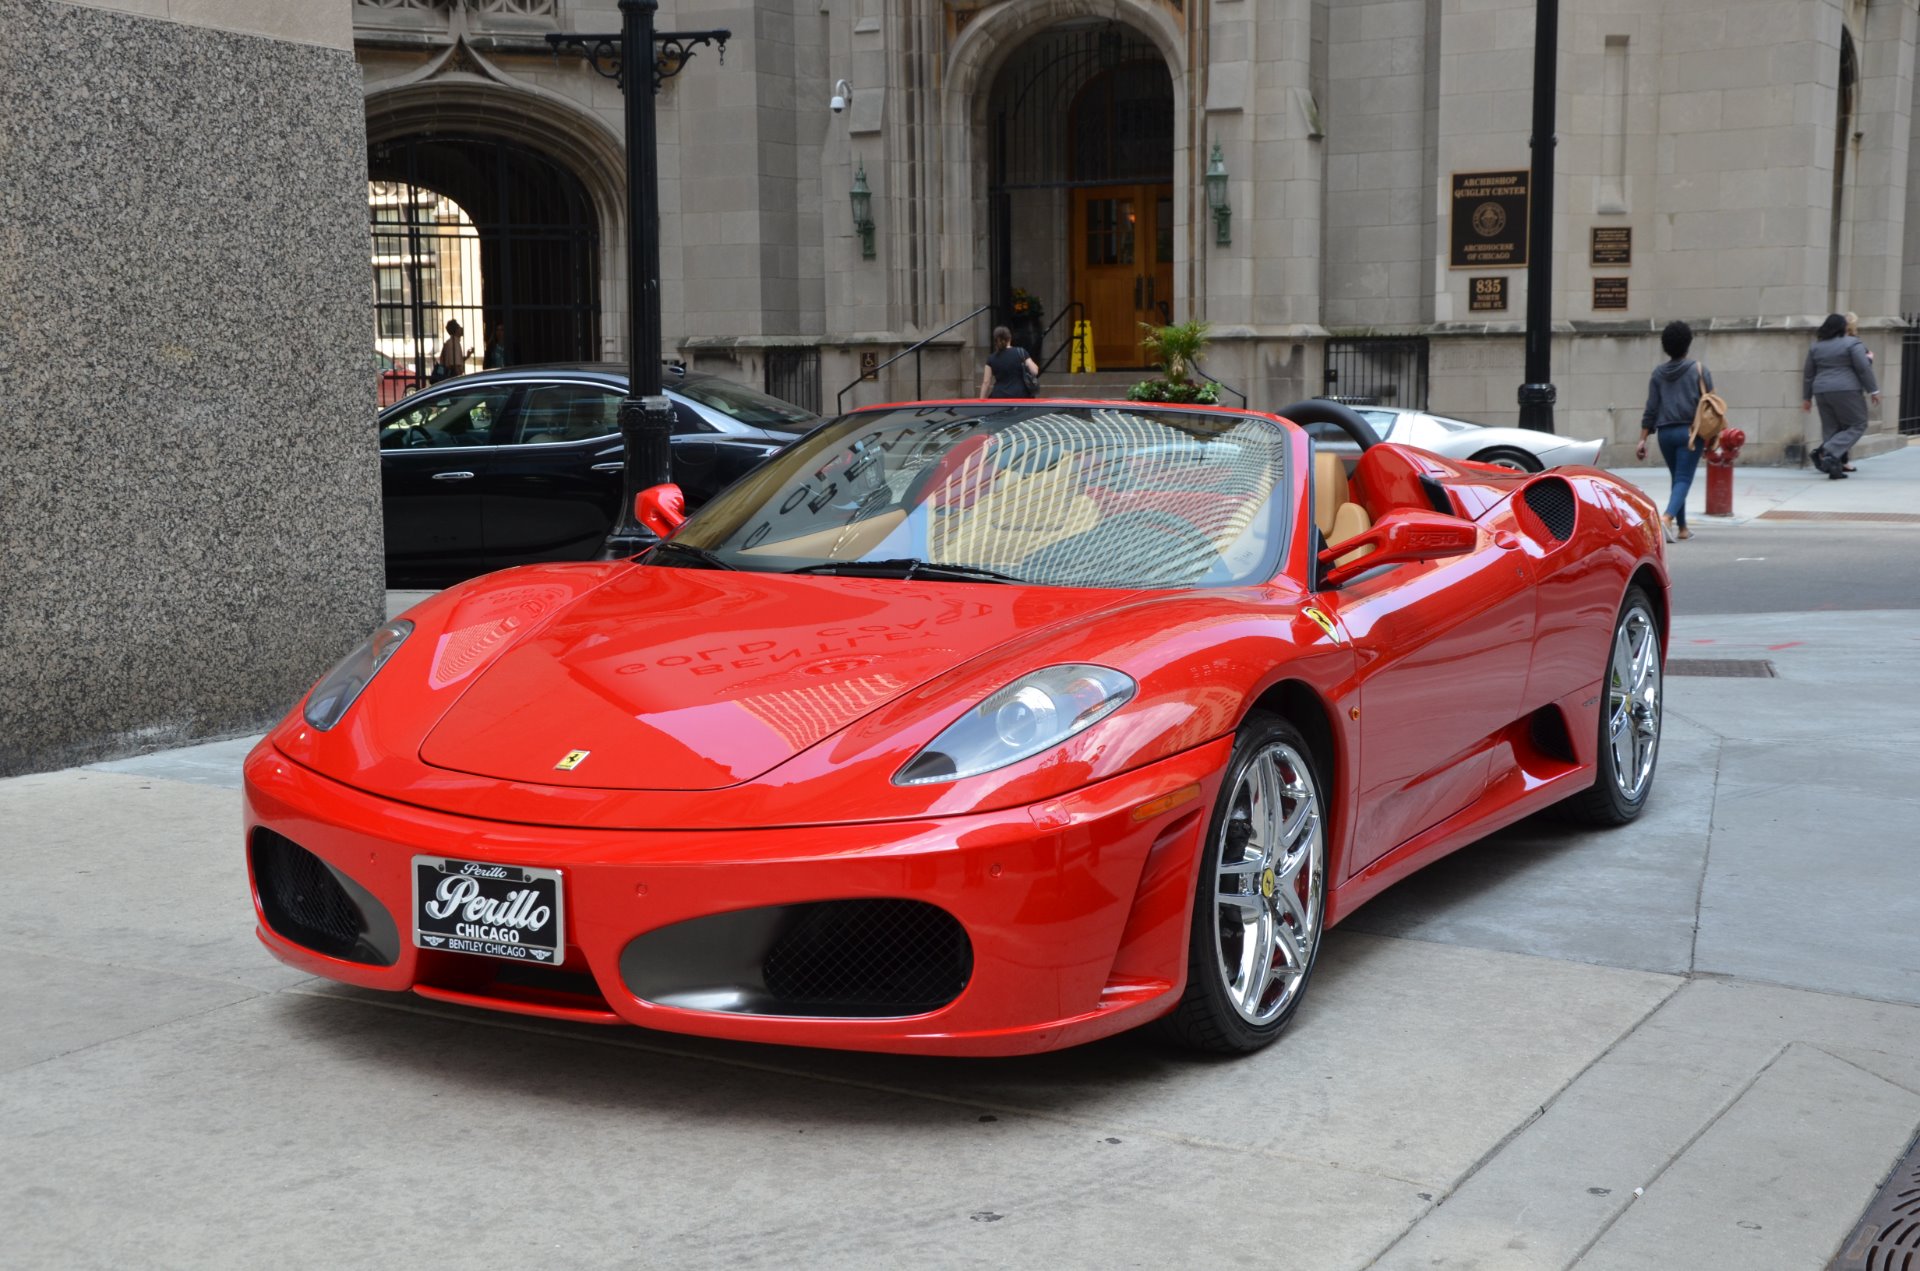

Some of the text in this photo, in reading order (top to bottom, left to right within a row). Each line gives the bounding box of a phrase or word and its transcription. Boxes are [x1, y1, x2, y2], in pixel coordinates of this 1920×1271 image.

[1463, 176, 1518, 187] ARCHBISHOP
[1454, 186, 1526, 198] QUIGLEY CENTER
[1463, 243, 1514, 252] ARCHDIOCESE
[1478, 252, 1510, 260] CHICAGO
[1476, 280, 1501, 293] 835
[460, 863, 508, 878] Perillo
[425, 875, 550, 931] Perillo
[455, 923, 520, 943] CHICAGO
[448, 939, 526, 958] BENTLEY CHICAGO
